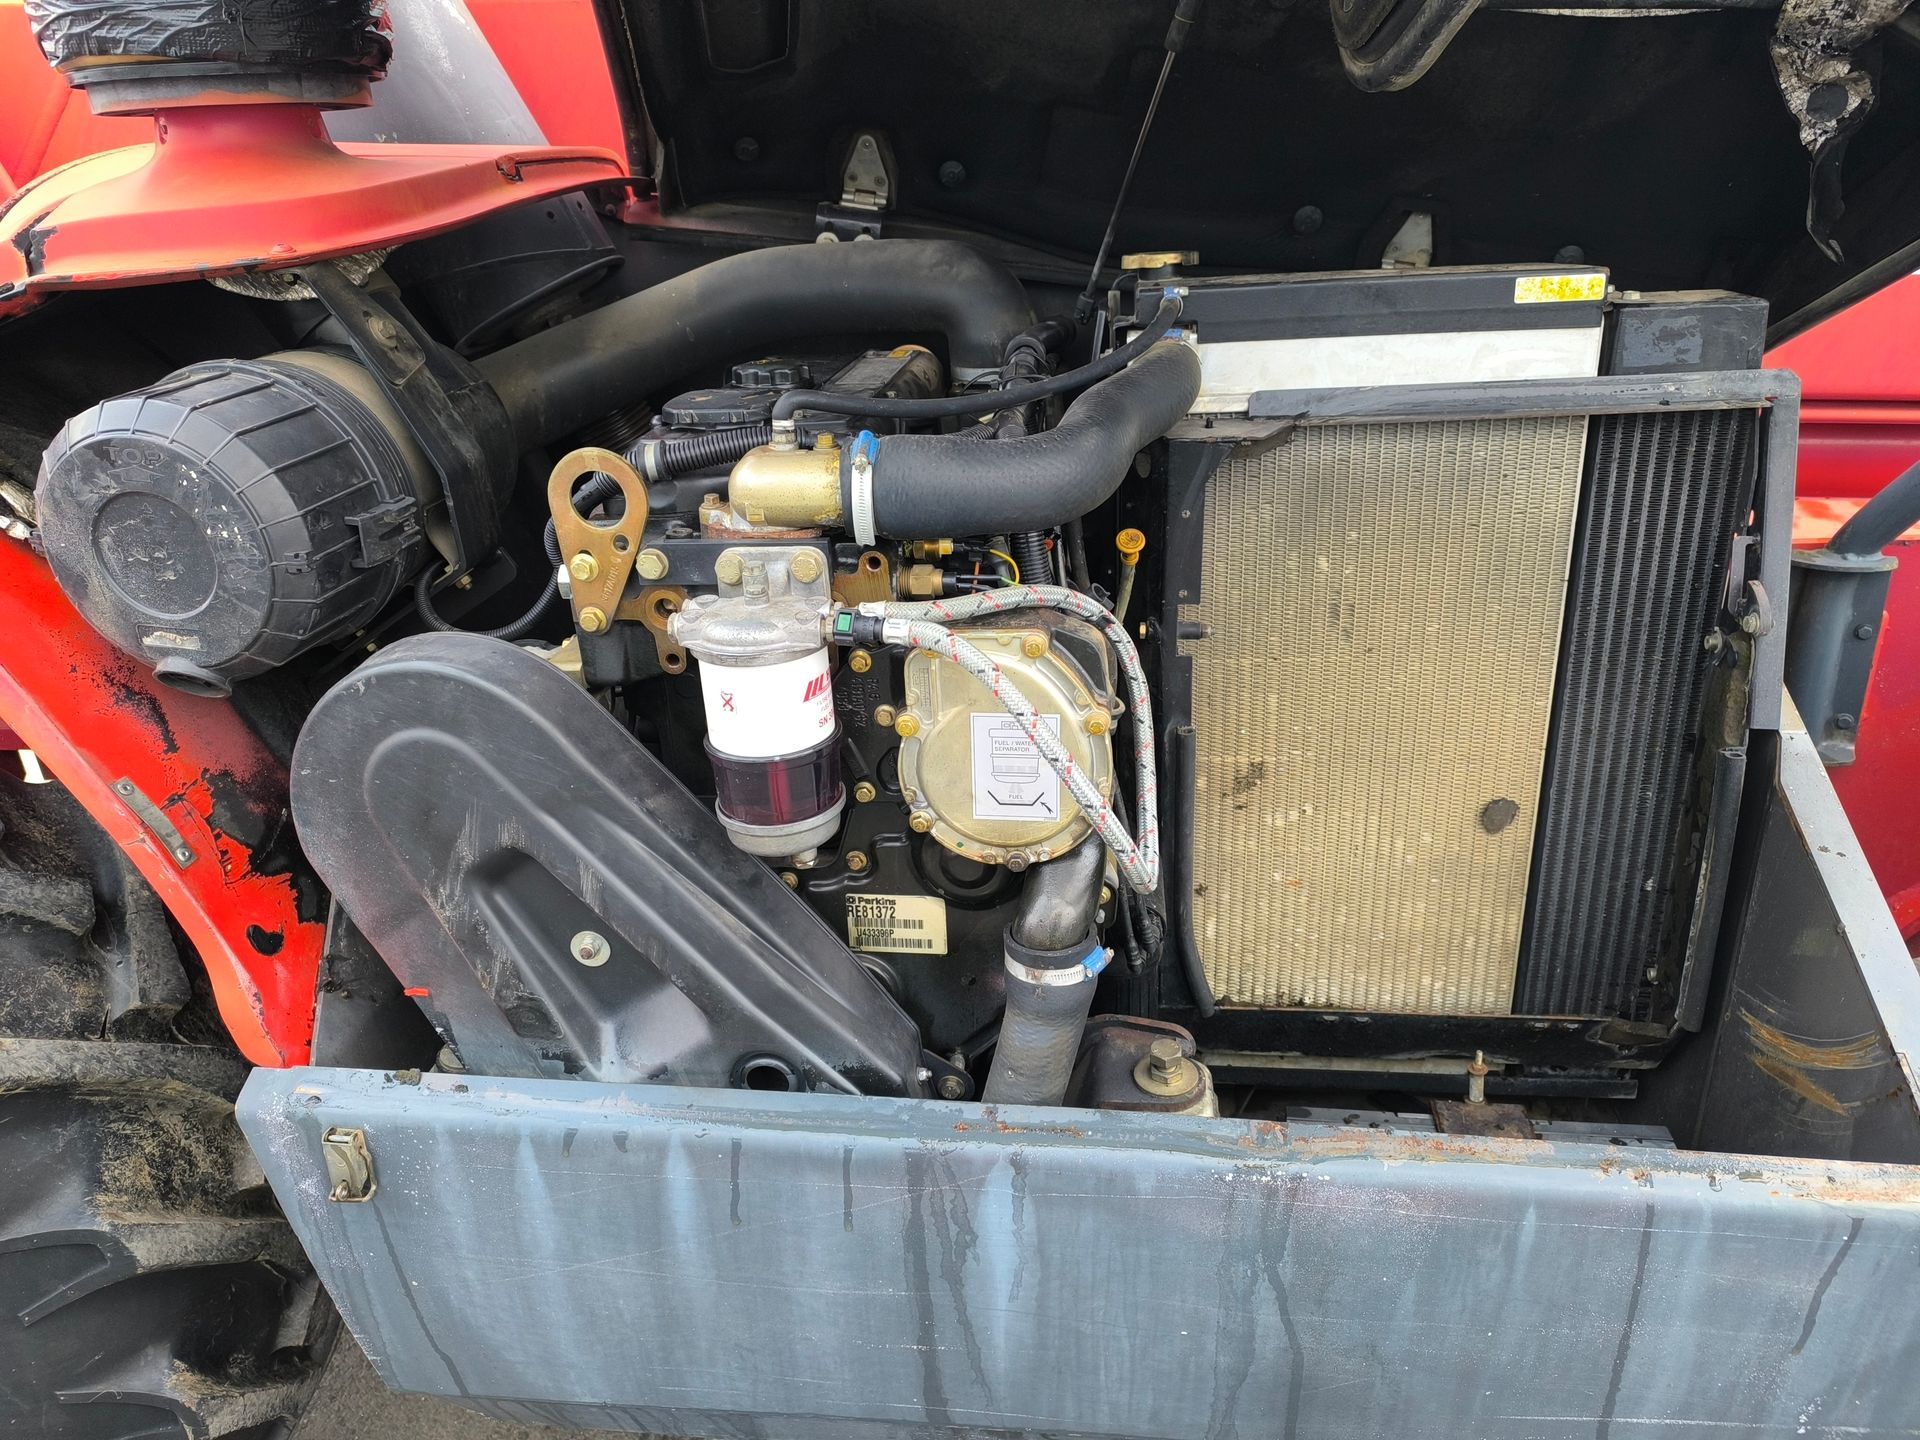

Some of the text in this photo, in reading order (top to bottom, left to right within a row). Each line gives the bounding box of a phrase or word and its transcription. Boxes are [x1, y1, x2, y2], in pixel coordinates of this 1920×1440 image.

[103, 446, 166, 467] TOP
[857, 896, 897, 905] Perkins
[847, 904, 896, 919] RE81372
[856, 928, 895, 938] U433396P
